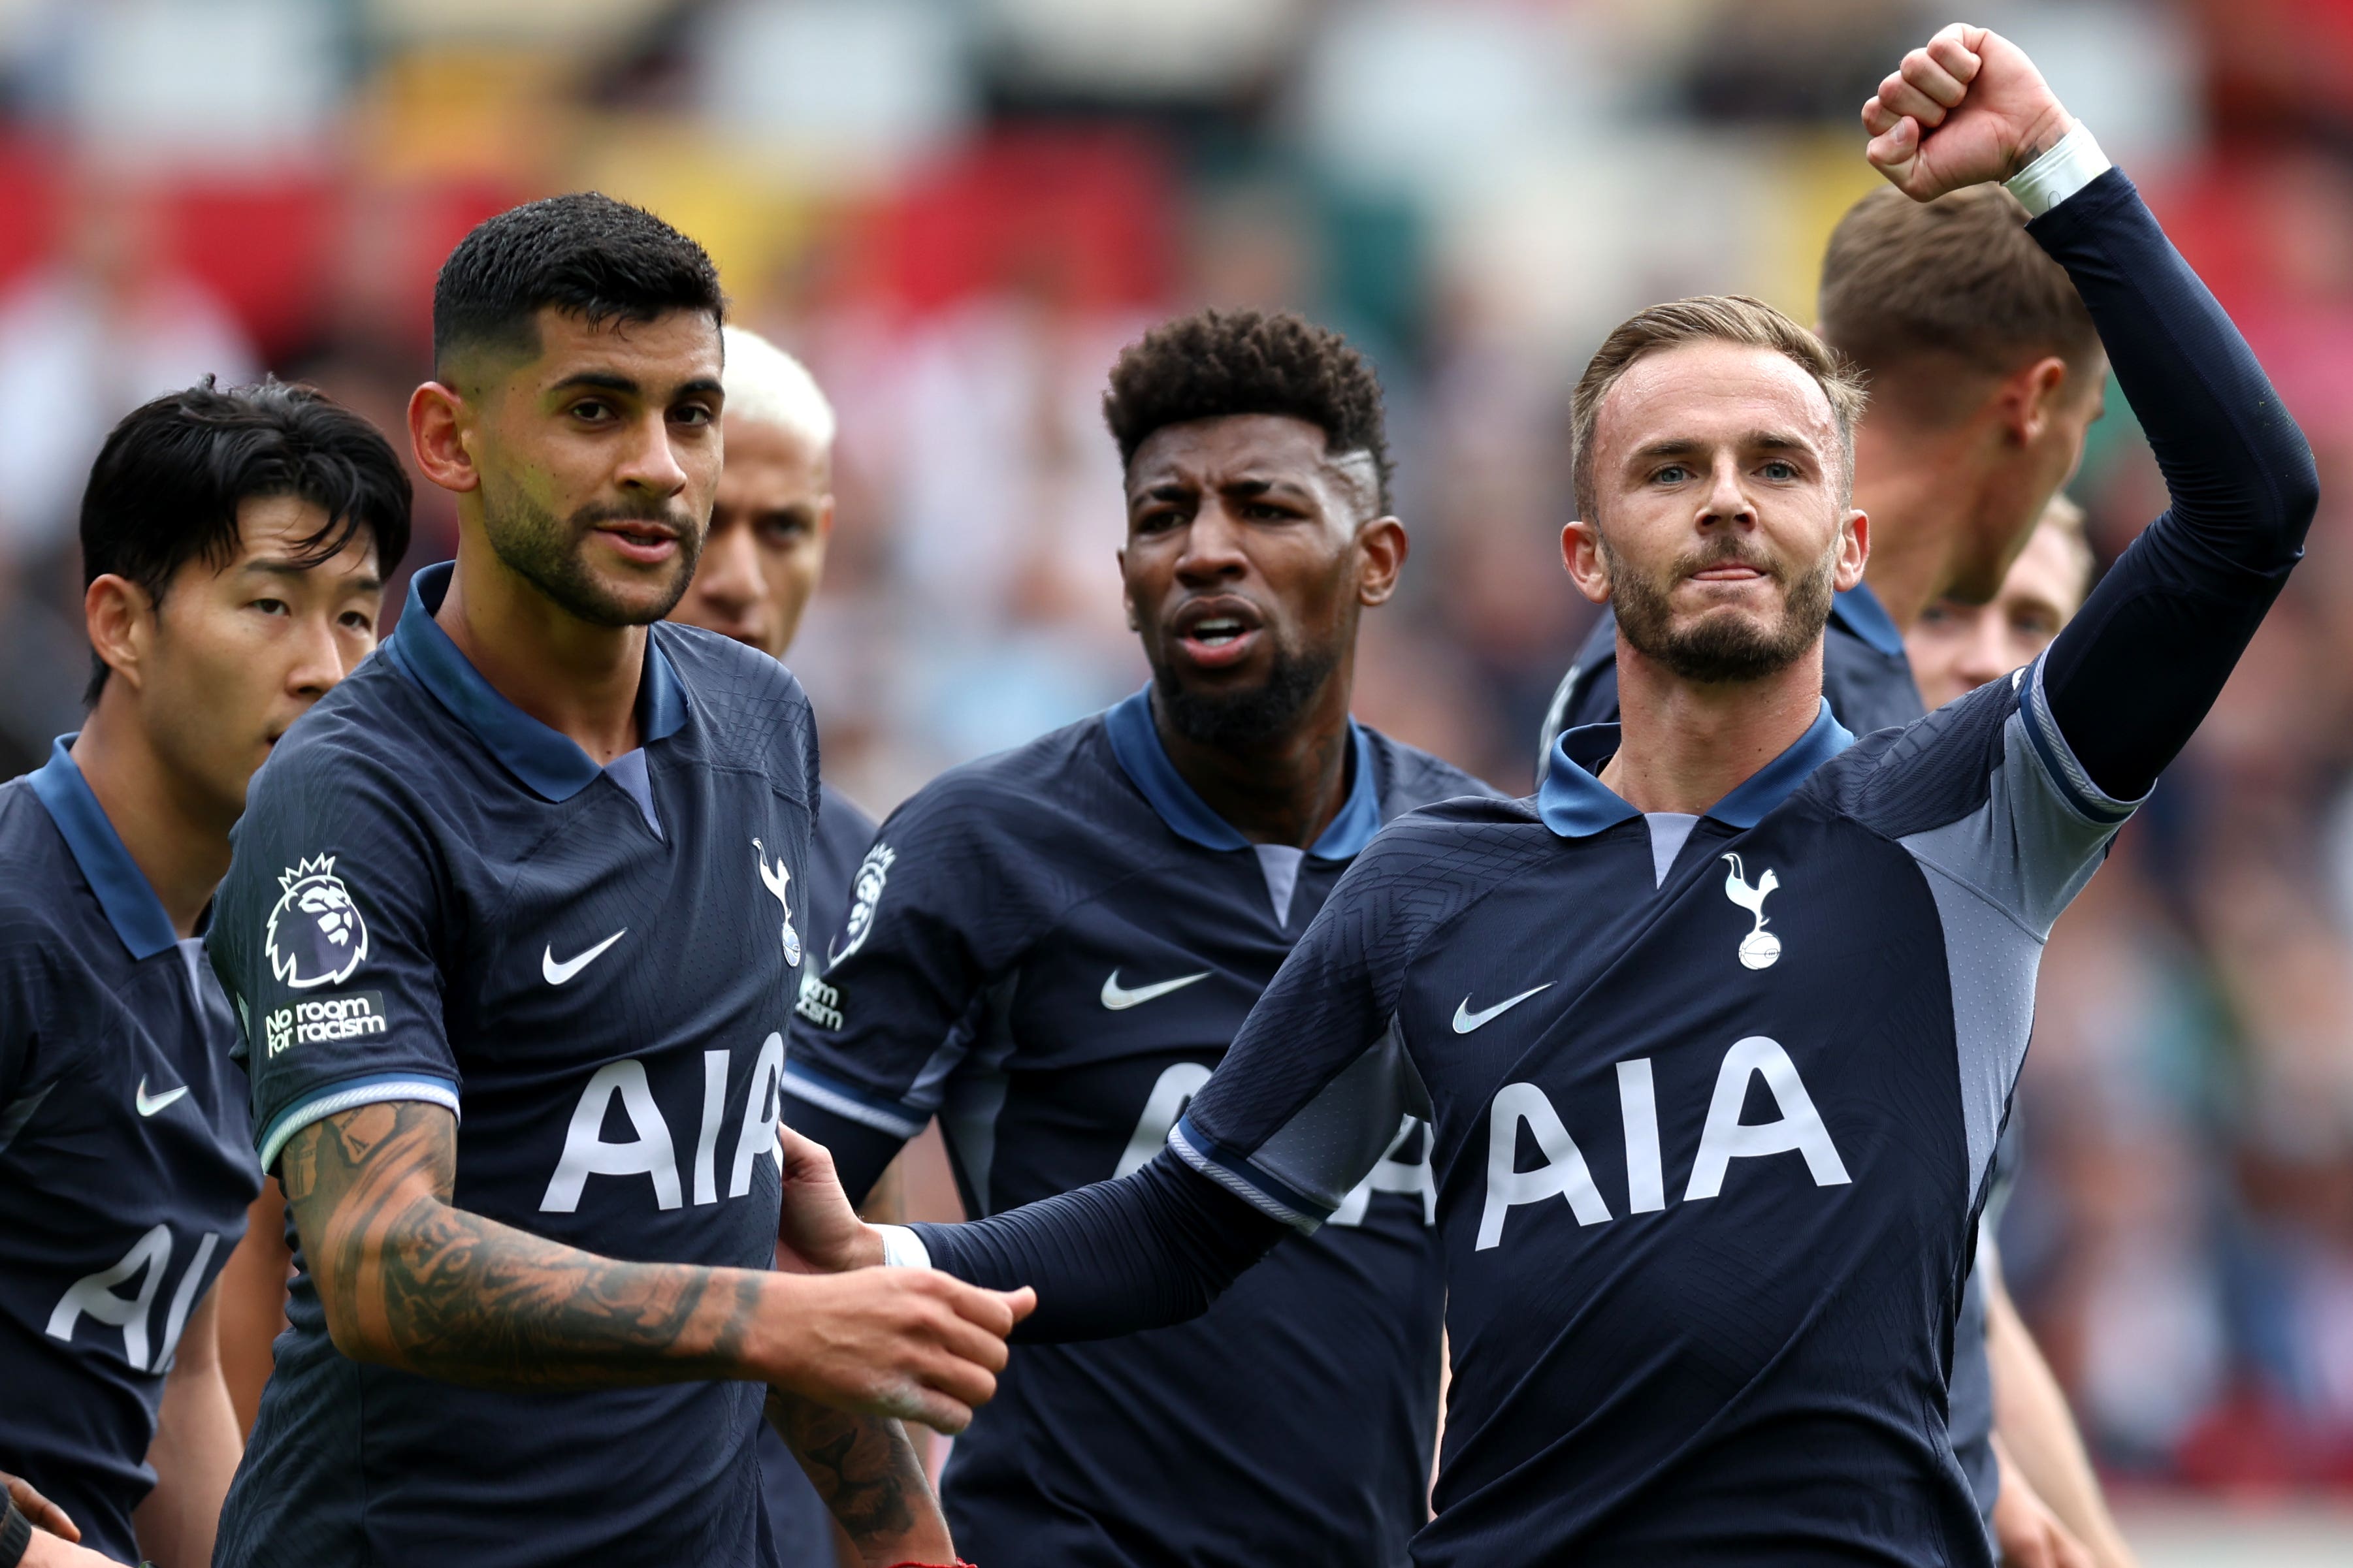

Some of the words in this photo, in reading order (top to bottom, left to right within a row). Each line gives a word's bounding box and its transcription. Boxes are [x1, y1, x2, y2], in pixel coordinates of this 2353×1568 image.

[265, 1009, 292, 1038] No
[296, 997, 370, 1023] room
[268, 1027, 293, 1059] for
[297, 1016, 385, 1044] racism
[539, 1032, 783, 1212] AIA
[1475, 1036, 1853, 1251] AIA
[45, 1223, 219, 1374] AI
